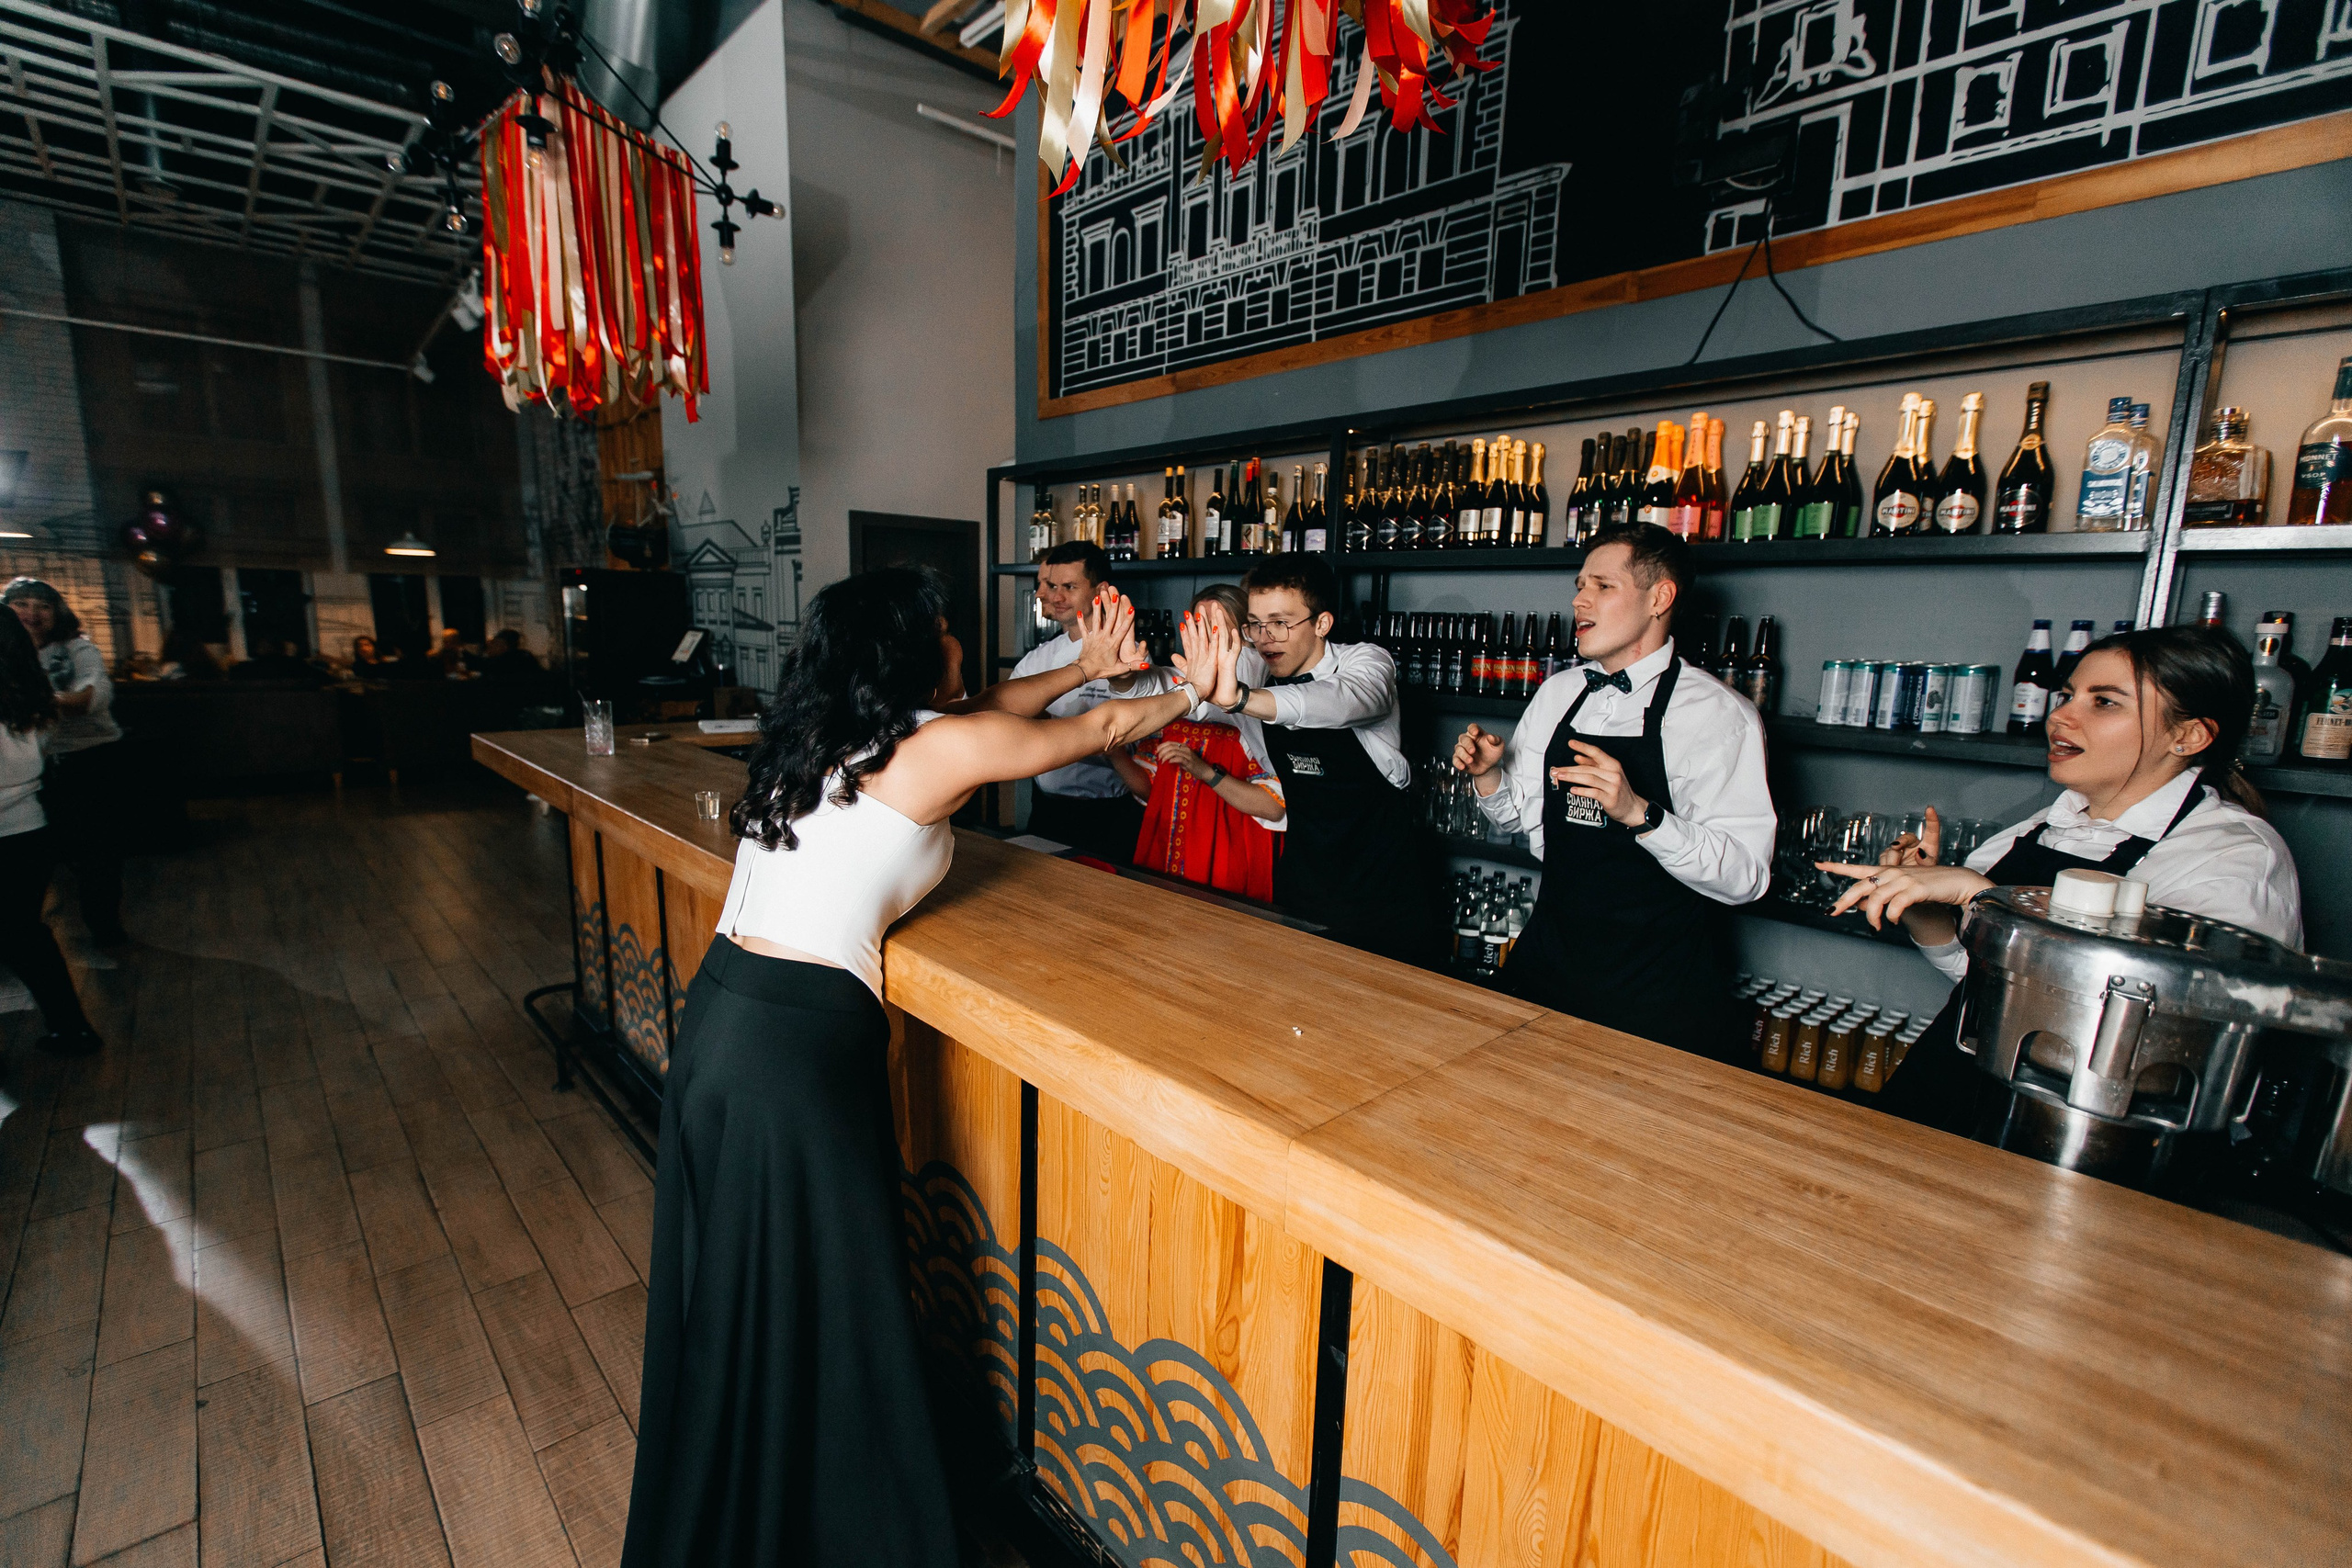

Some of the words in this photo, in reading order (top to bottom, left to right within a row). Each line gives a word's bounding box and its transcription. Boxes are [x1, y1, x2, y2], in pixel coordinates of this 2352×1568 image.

[2029, 401, 2041, 430] BRUT
[2300, 453, 2338, 463] MONNET
[1882, 506, 1916, 515] MARTINI
[1567, 806, 1601, 822] БИРЖА
[1751, 1020, 1764, 1042] Rich
[1768, 1032, 1781, 1055] Rich
[1799, 1041, 1812, 1064] Rich
[1826, 1048, 1838, 1072] Rich
[1863, 1051, 1877, 1076] Rich
